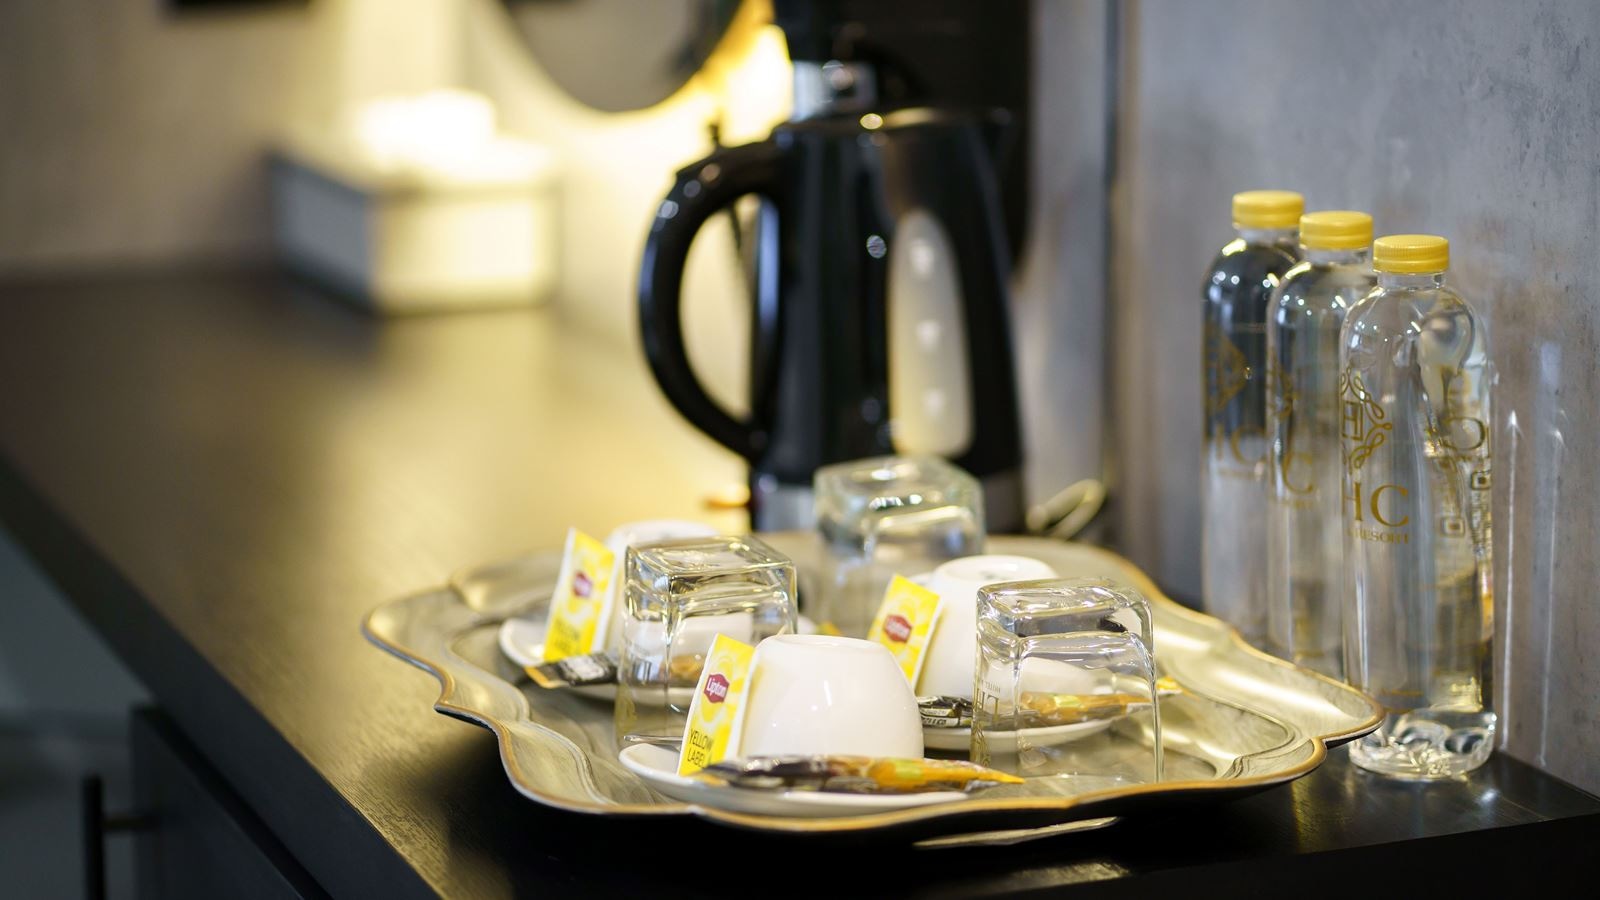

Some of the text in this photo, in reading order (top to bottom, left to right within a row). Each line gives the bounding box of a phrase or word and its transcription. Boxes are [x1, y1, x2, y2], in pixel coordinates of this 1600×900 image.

[706, 673, 727, 698] Lipton
[689, 728, 713, 751] YELLOW
[687, 747, 706, 769] LABEL
